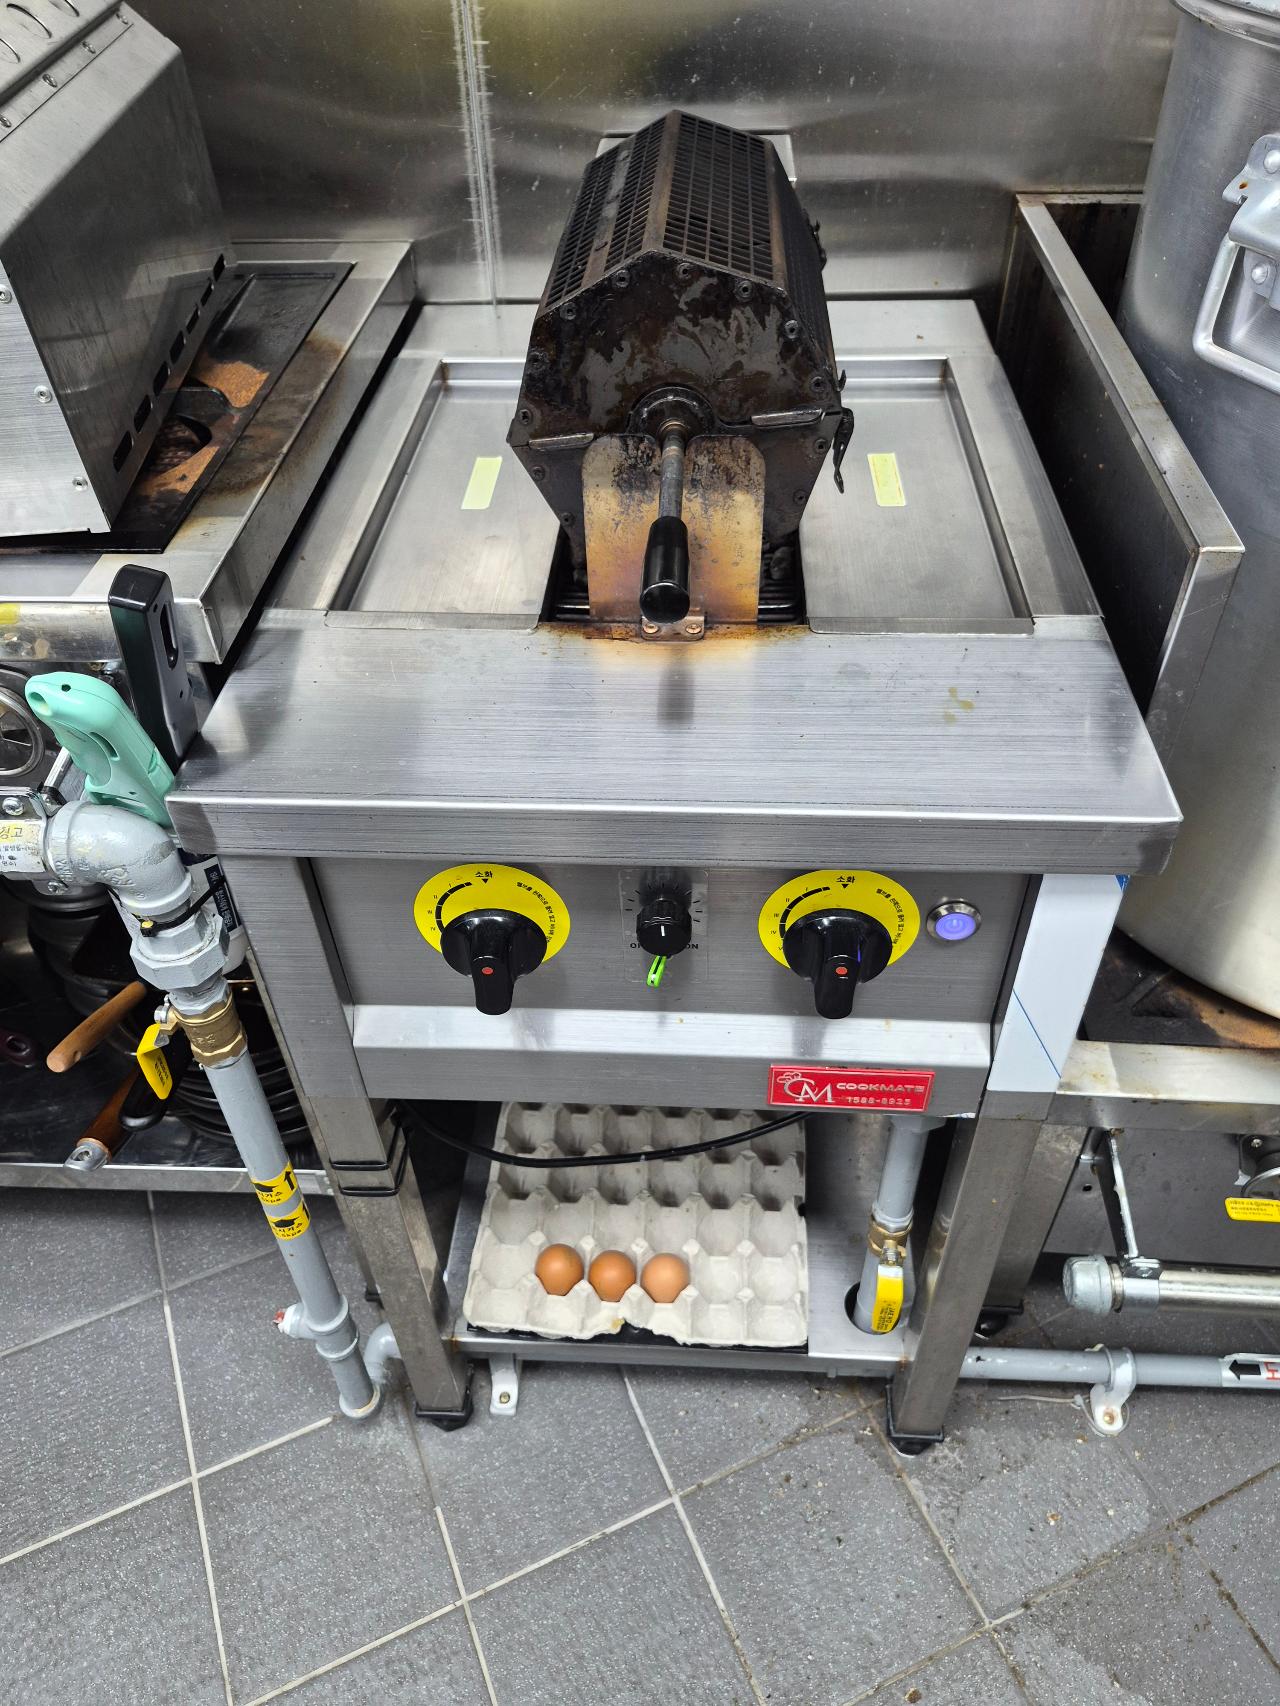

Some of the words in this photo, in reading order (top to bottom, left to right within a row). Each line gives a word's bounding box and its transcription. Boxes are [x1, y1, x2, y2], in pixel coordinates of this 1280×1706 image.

[475, 870, 493, 879] 소화
[836, 875, 855, 884] 소화
[836, 1082, 925, 1093] COOKMATE
